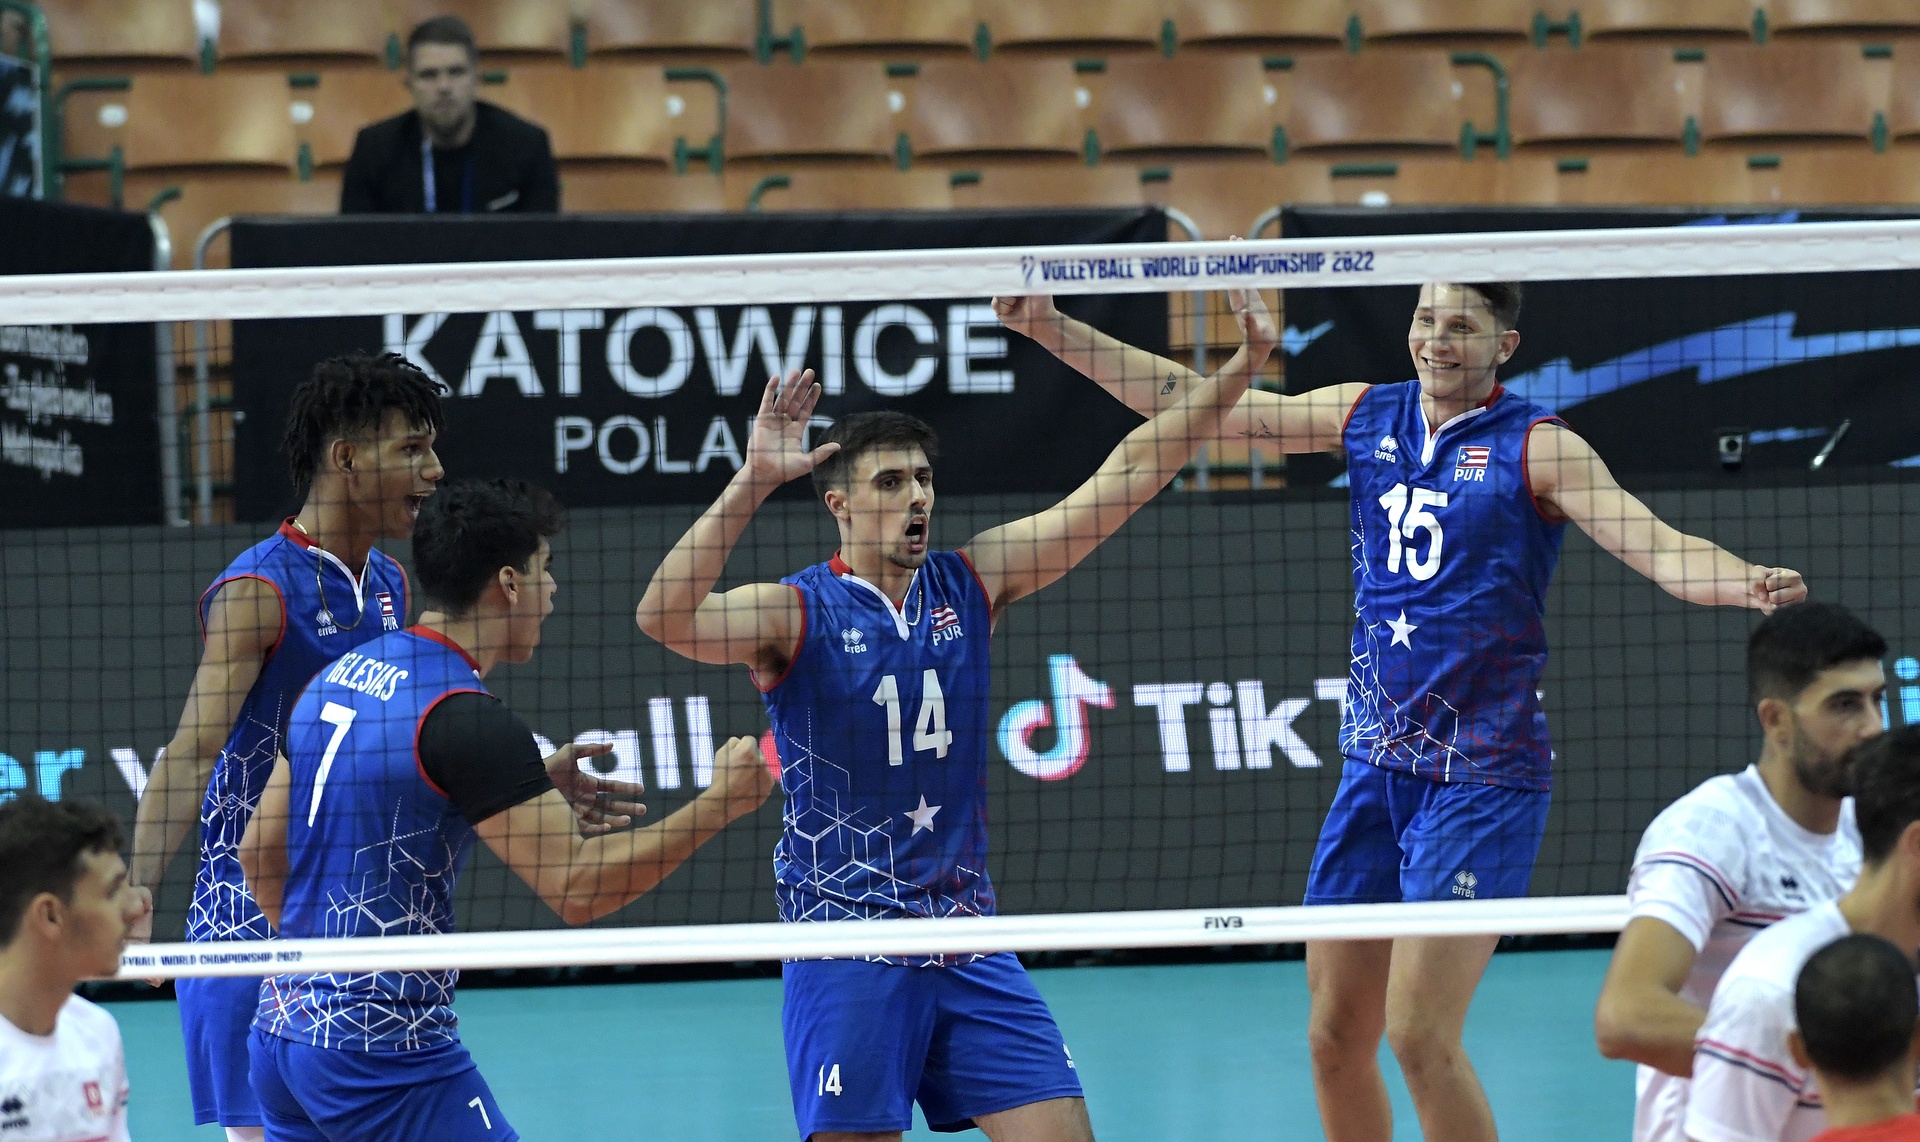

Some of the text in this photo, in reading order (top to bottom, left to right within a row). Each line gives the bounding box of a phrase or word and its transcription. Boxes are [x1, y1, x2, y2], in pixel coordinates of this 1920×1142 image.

[1041, 250, 1375, 281] VOLLEYBALL WORLD CHAMPIONSHIP 2022
[383, 303, 1015, 399] KATOWICE
[1454, 468, 1486, 482] PUR
[1378, 482, 1449, 581] 15
[382, 616, 399, 631] PUR
[932, 625, 964, 647] PUR
[325, 652, 409, 702] IGLESIAS
[872, 668, 953, 766] 14
[308, 701, 357, 828] 7
[818, 1063, 843, 1097] 14
[468, 1096, 492, 1130] 7
